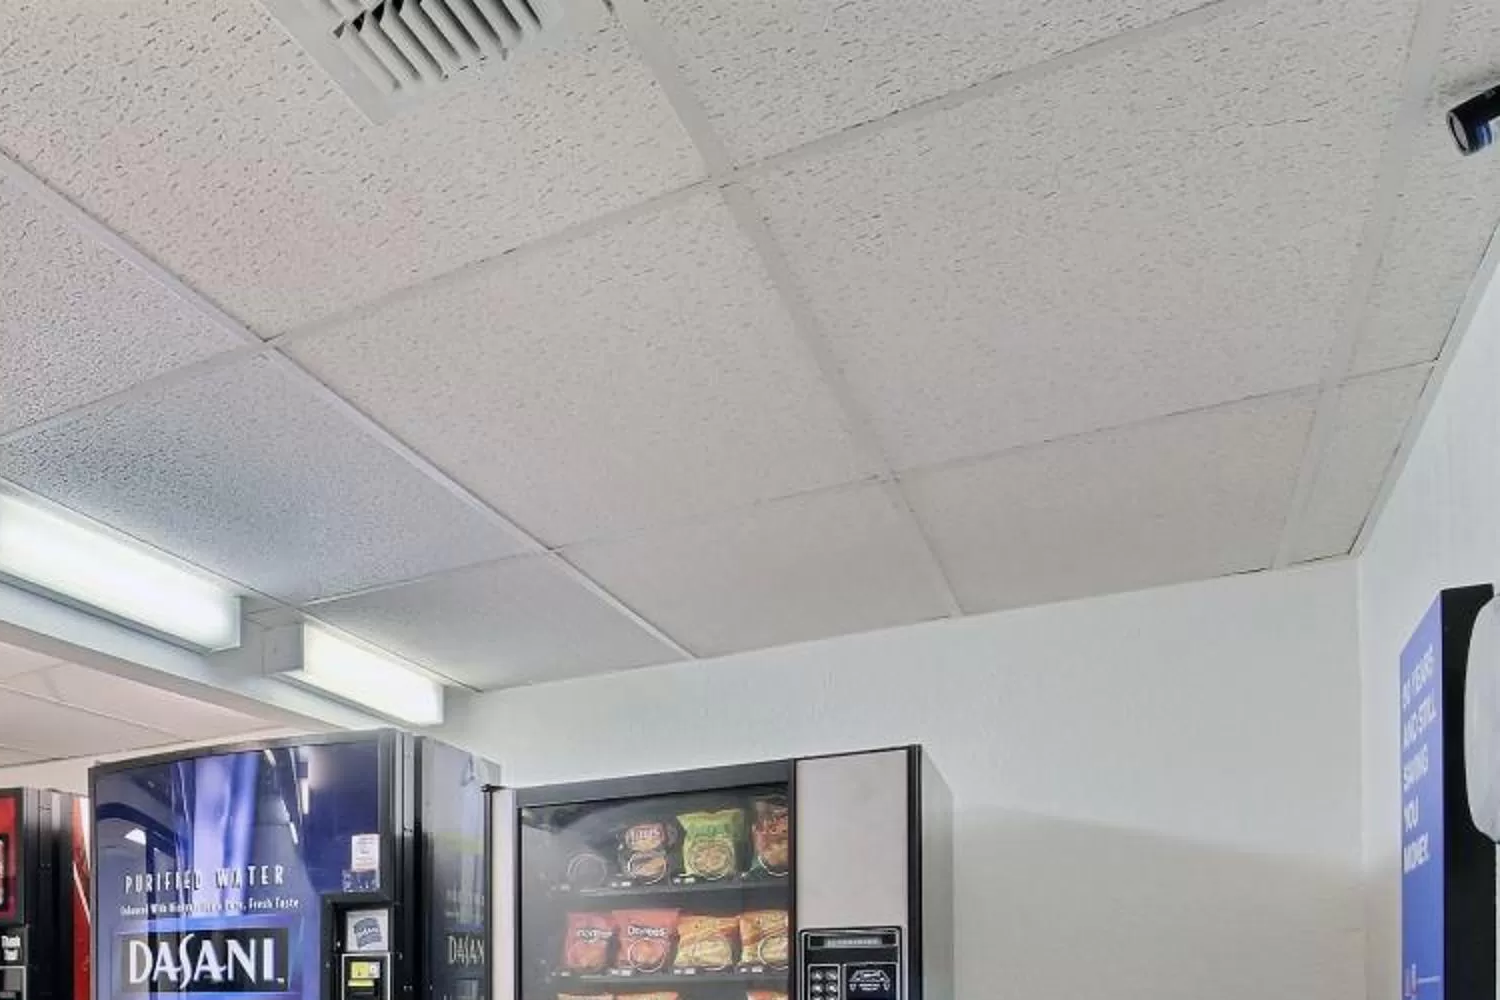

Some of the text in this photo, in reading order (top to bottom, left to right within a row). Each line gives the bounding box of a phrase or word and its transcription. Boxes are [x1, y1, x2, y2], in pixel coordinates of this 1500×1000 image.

[1404, 795, 1419, 833] YOU
[125, 864, 285, 894] PURIFIED WATER
[129, 932, 275, 989] DASANI
[448, 935, 485, 967] DASAN
